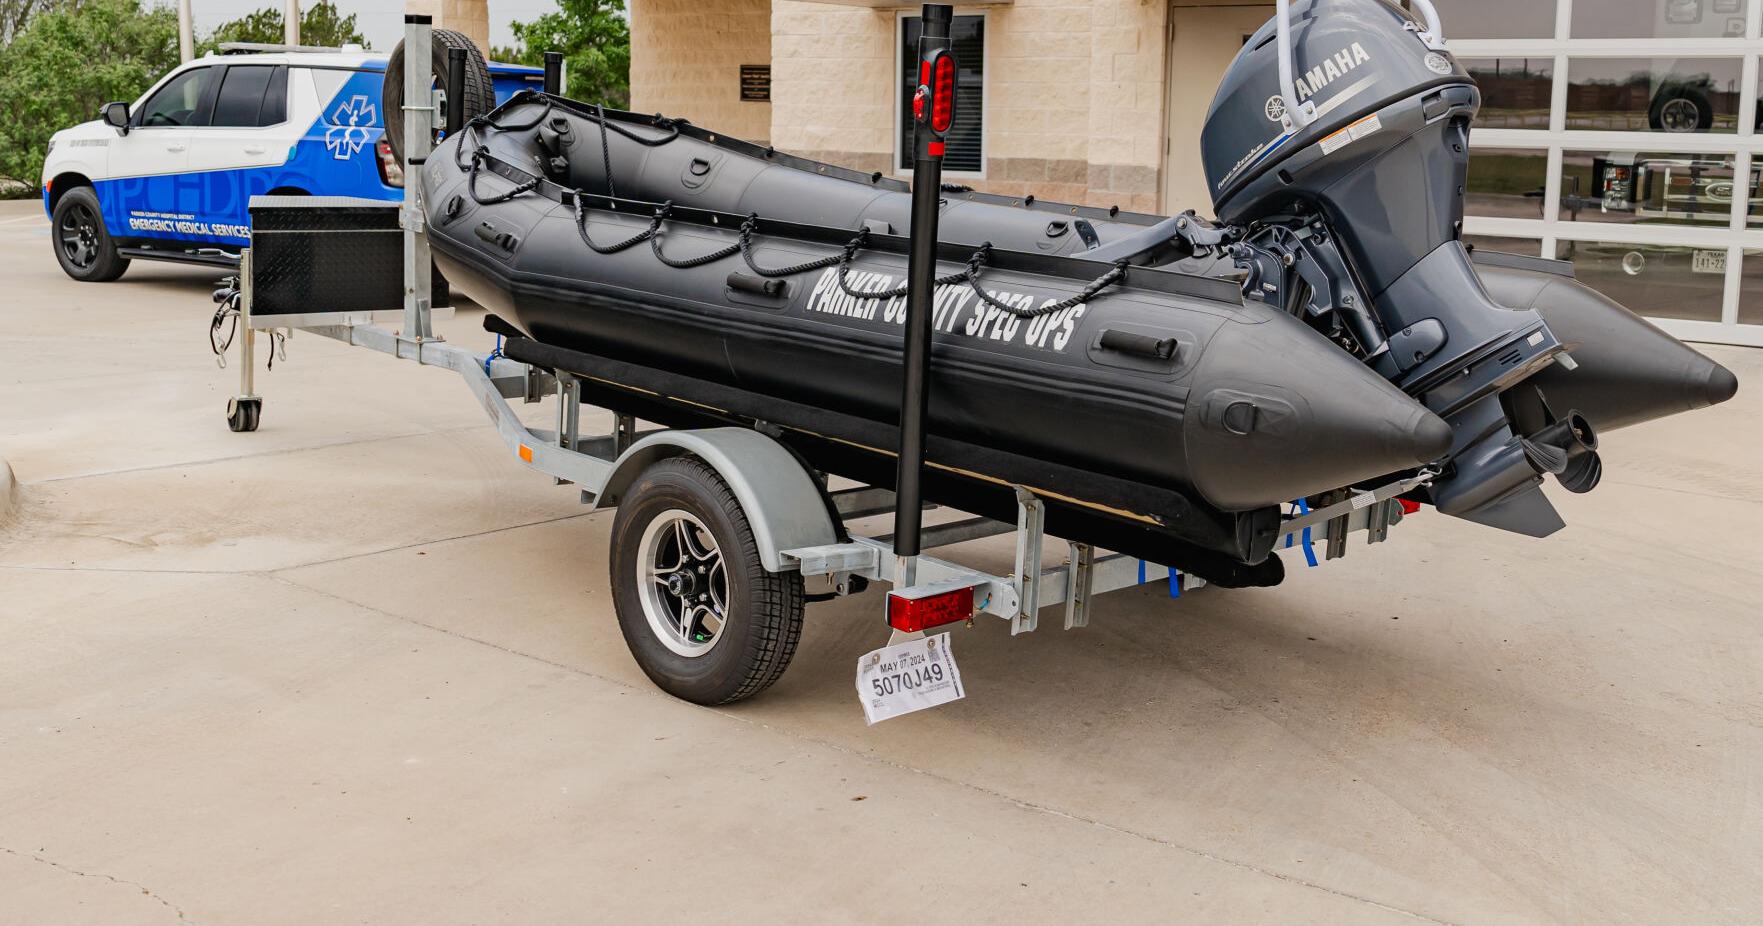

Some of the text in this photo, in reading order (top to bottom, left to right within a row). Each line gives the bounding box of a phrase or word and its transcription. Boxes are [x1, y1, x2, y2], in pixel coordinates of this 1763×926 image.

[1295, 42, 1371, 101] AMAHA
[129, 217, 252, 239] EMERGENCY MEDICAL SERVICES
[806, 266, 1087, 351] PARKER CNTY SPEC OPS
[872, 663, 944, 697] 5070J49
[880, 661, 899, 673] MAY
[910, 653, 926, 666] 2024
